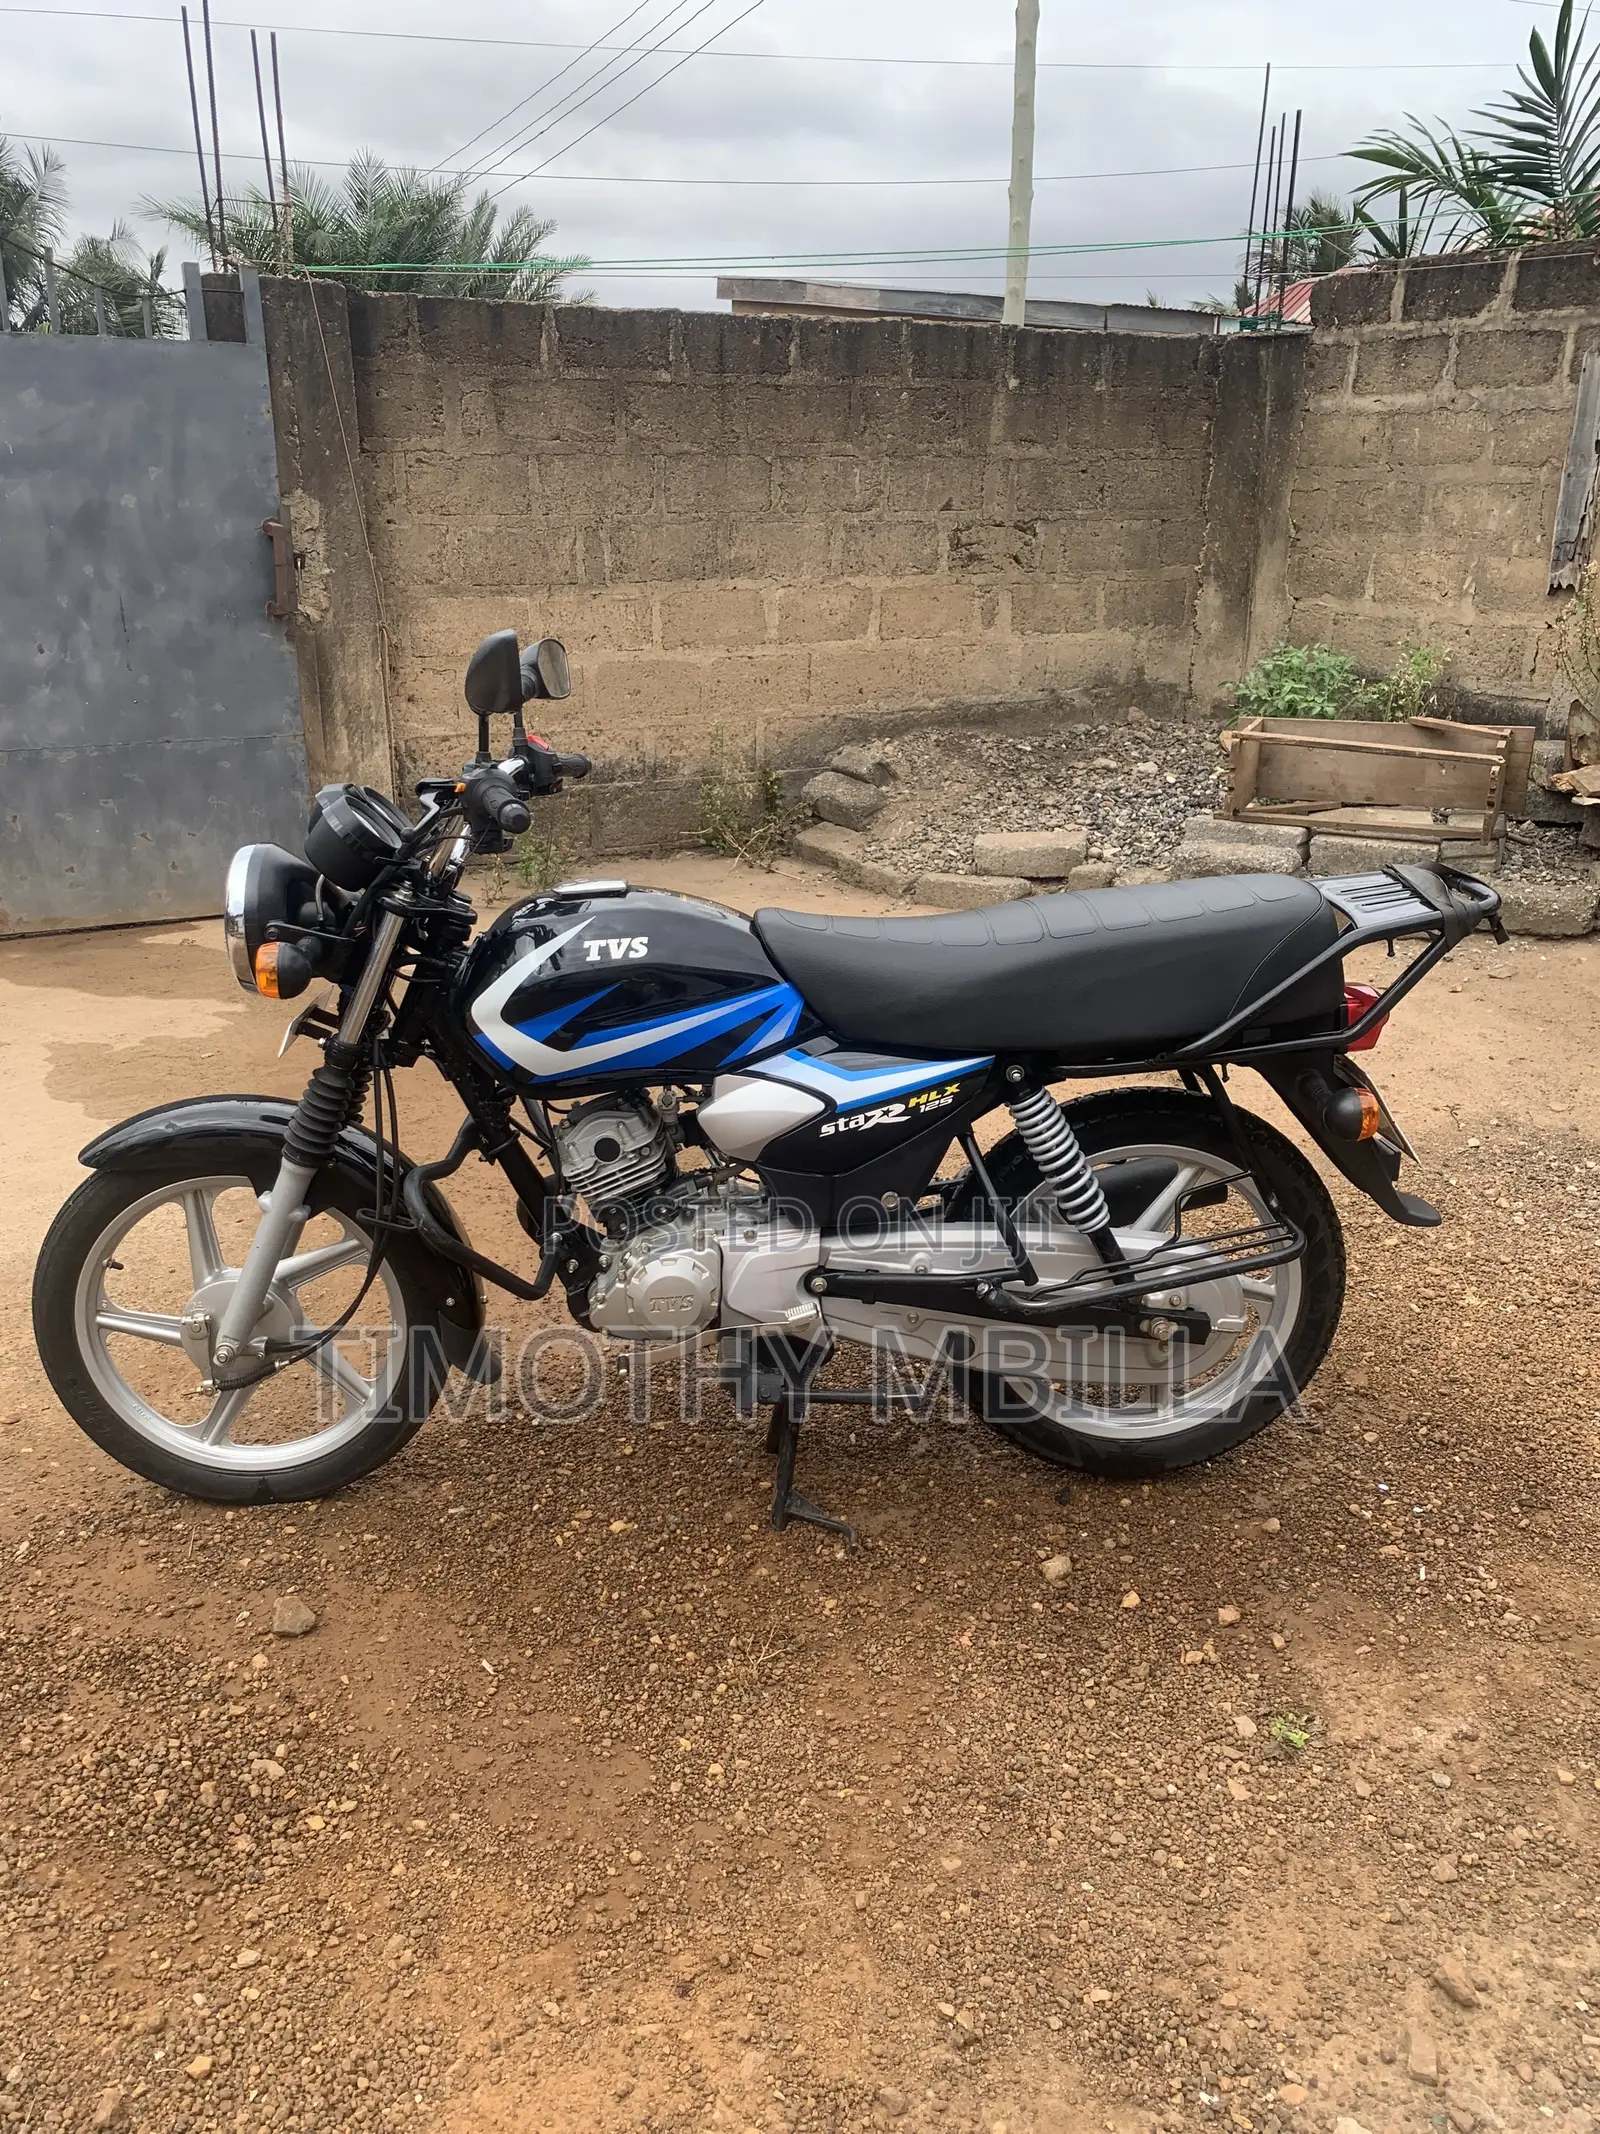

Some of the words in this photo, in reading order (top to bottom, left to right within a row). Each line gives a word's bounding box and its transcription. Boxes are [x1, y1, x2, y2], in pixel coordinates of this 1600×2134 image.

[583, 936, 649, 962] TVS
[907, 1082, 961, 1108] HLX
[919, 1095, 954, 1114] 125
[649, 1295, 694, 1313] TVS
